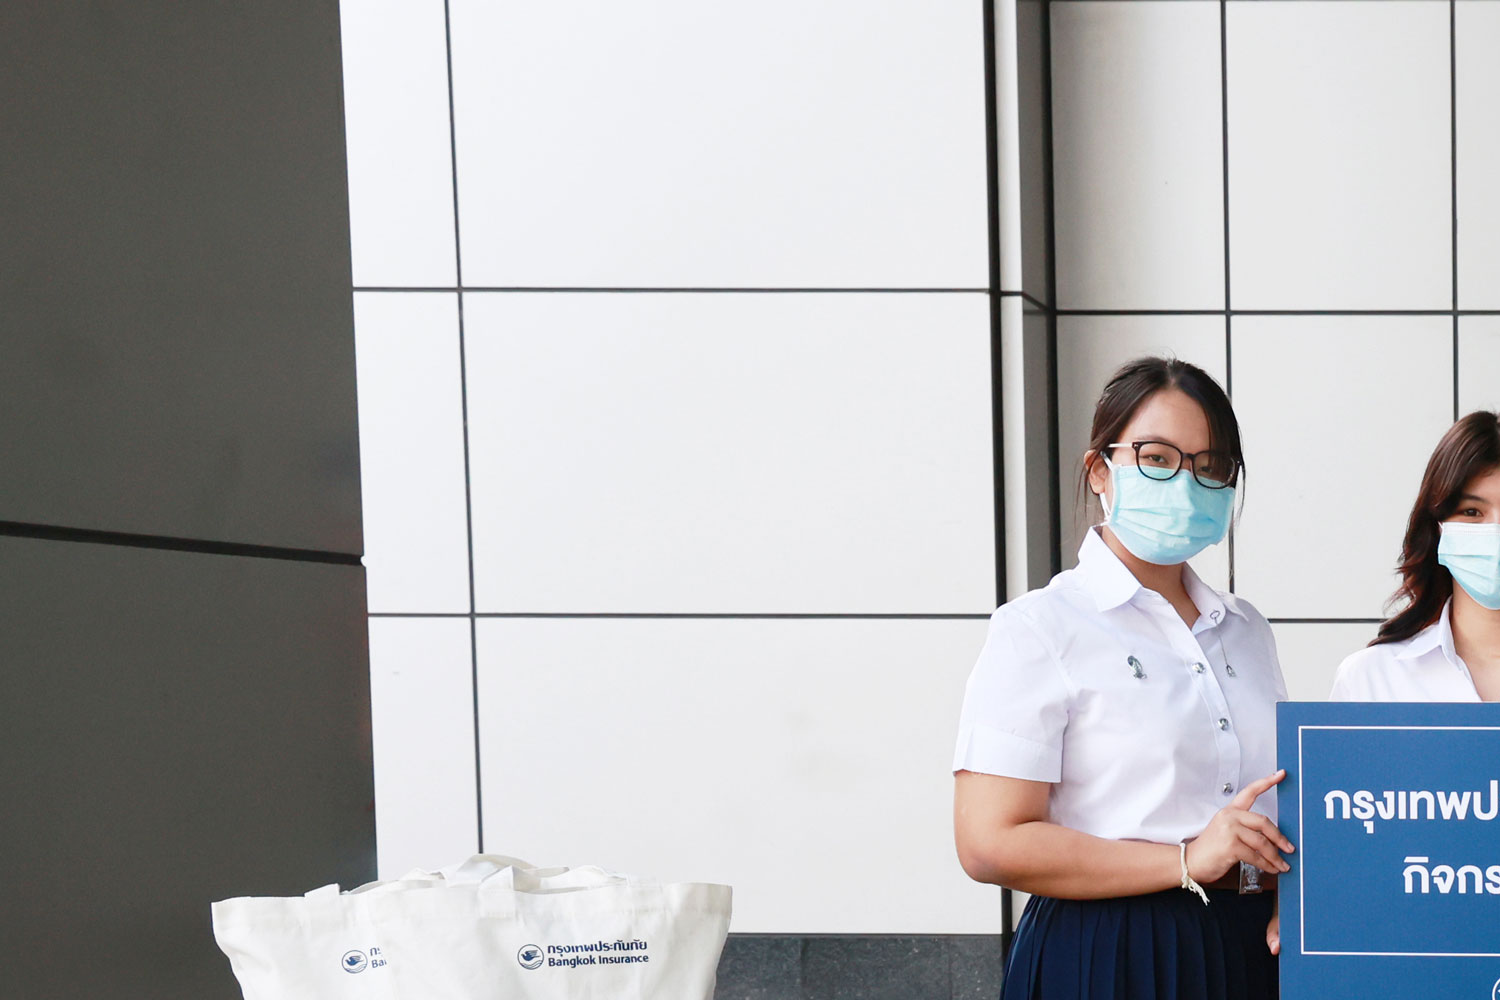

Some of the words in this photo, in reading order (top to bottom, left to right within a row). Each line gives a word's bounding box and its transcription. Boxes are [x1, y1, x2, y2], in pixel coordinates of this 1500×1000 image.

[547, 939, 648, 957] กรุงเทพประกันภัย
[548, 954, 597, 969] Bangkok
[598, 955, 649, 965] Insurance
